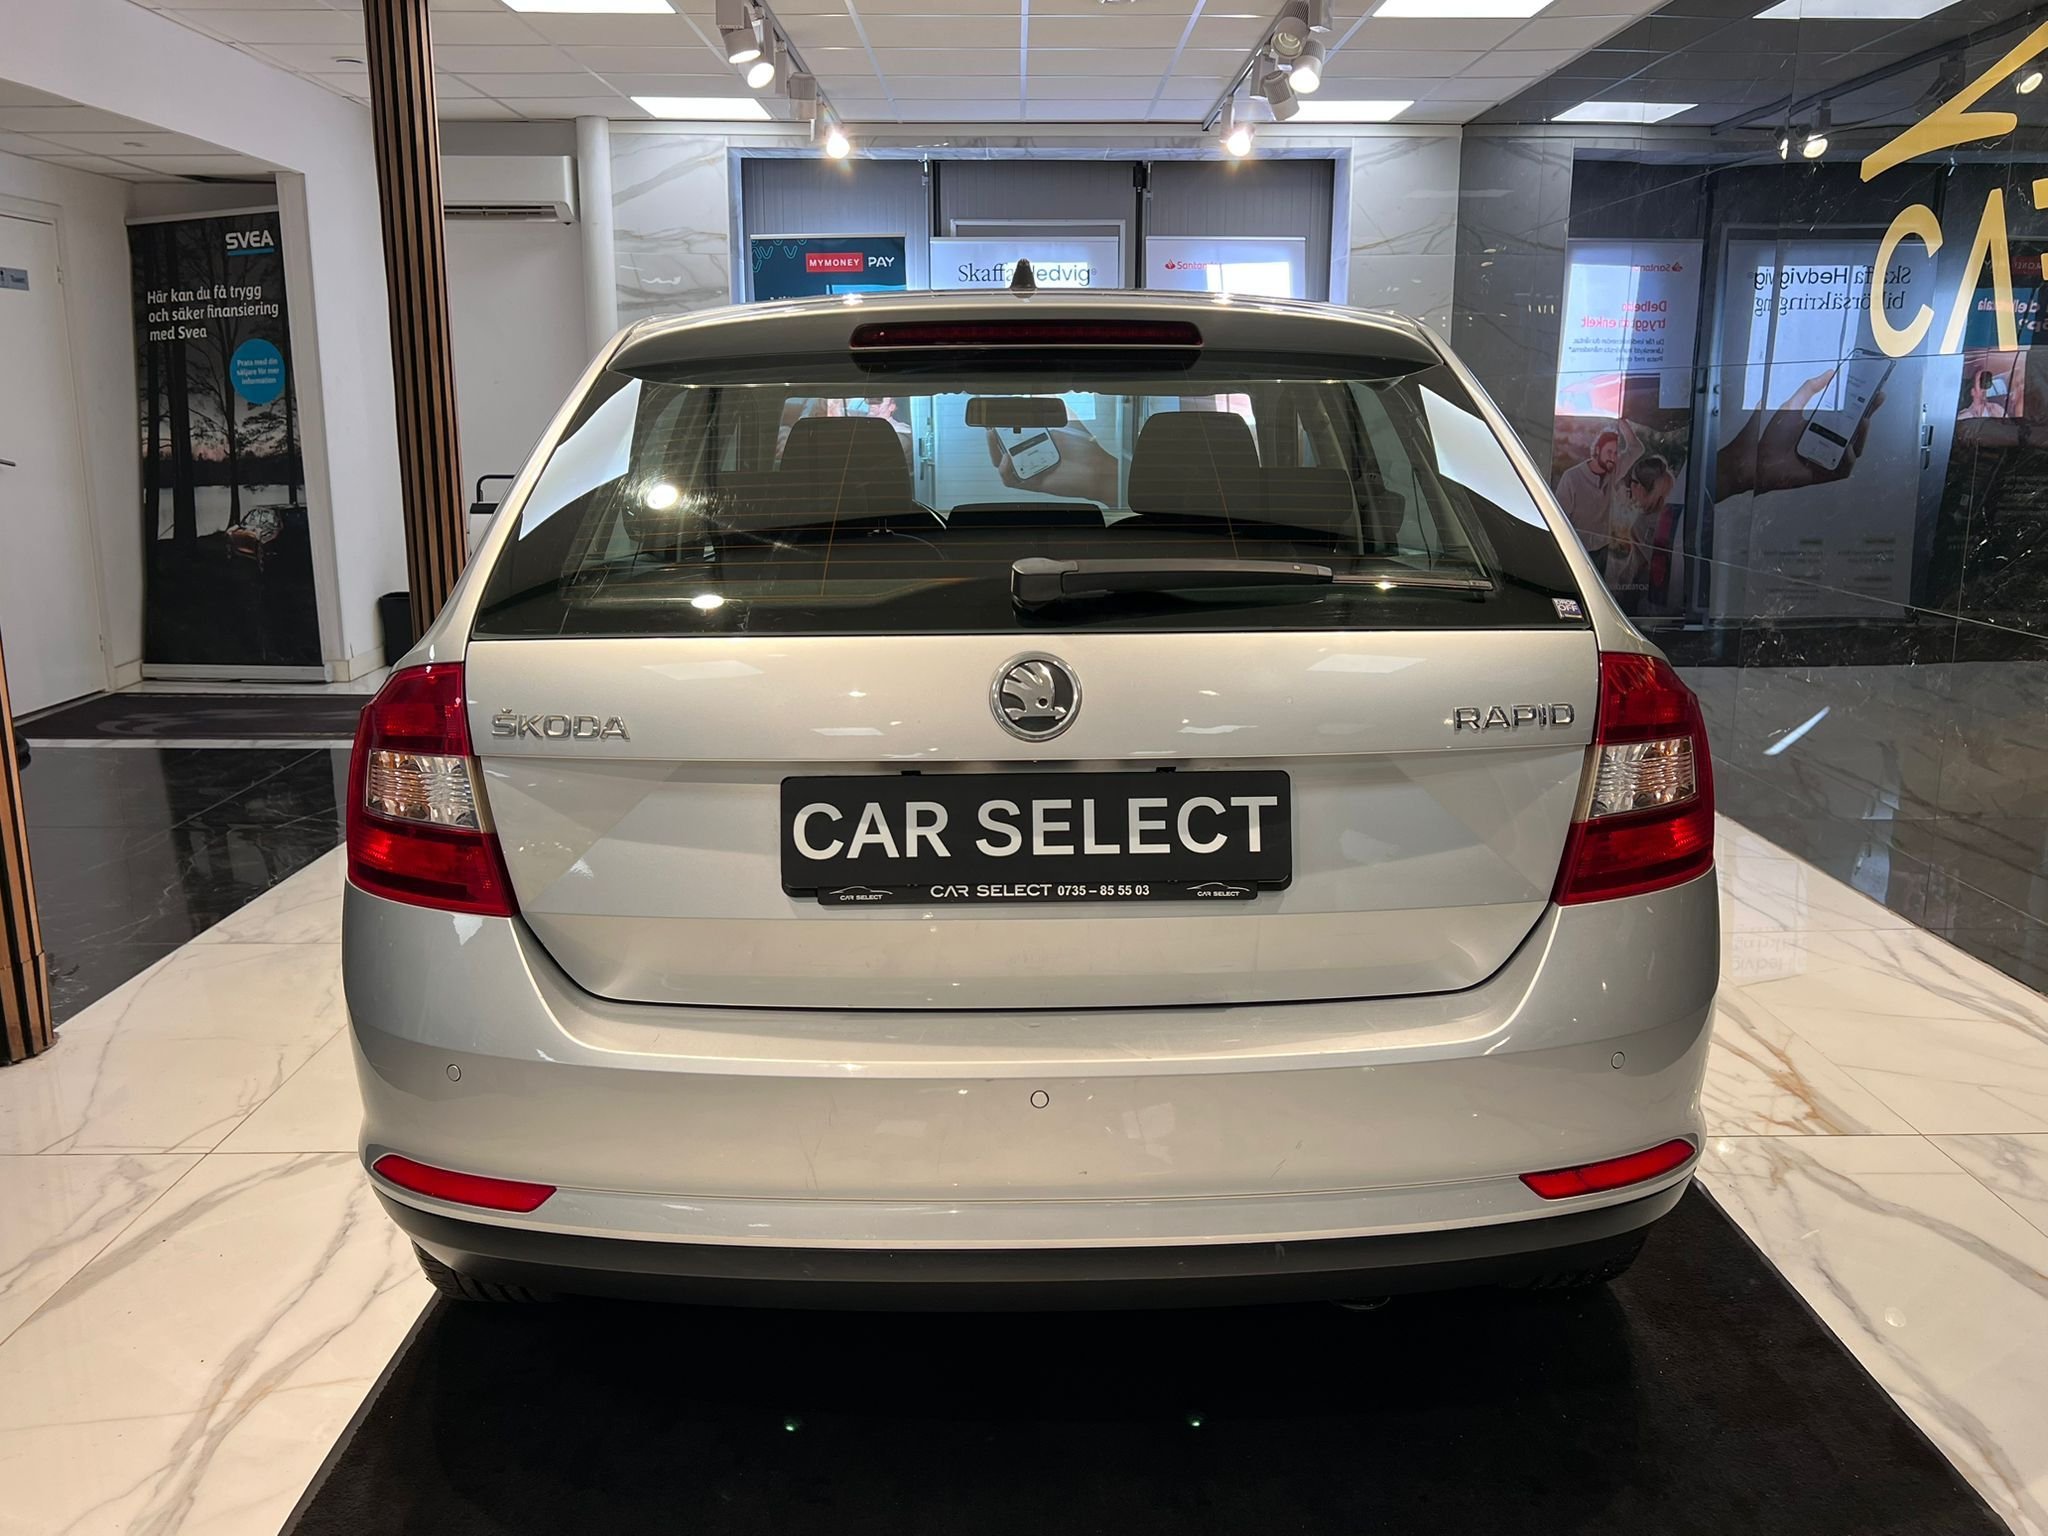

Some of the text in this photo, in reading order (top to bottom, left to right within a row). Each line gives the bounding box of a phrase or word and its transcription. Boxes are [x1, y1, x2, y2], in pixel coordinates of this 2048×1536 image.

[225, 229, 274, 249] SVEA
[809, 256, 895, 268] MYMONEY PAY
[958, 262, 1014, 282] Skaffa
[147, 285, 262, 304] Här kan du få trygg
[148, 302, 279, 323] och säker finansiering
[150, 325, 208, 342] med Svea
[491, 707, 631, 741] ŠKODA
[1453, 702, 1575, 730] RAPID
[792, 795, 1279, 861] CAR SELECT
[930, 885, 969, 898] CAR
[976, 883, 1052, 898] SELECT
[1057, 885, 1086, 896] 0735
[1100, 884, 1115, 896] 85
[1117, 884, 1133, 896] 55
[1135, 884, 1150, 896] 03
